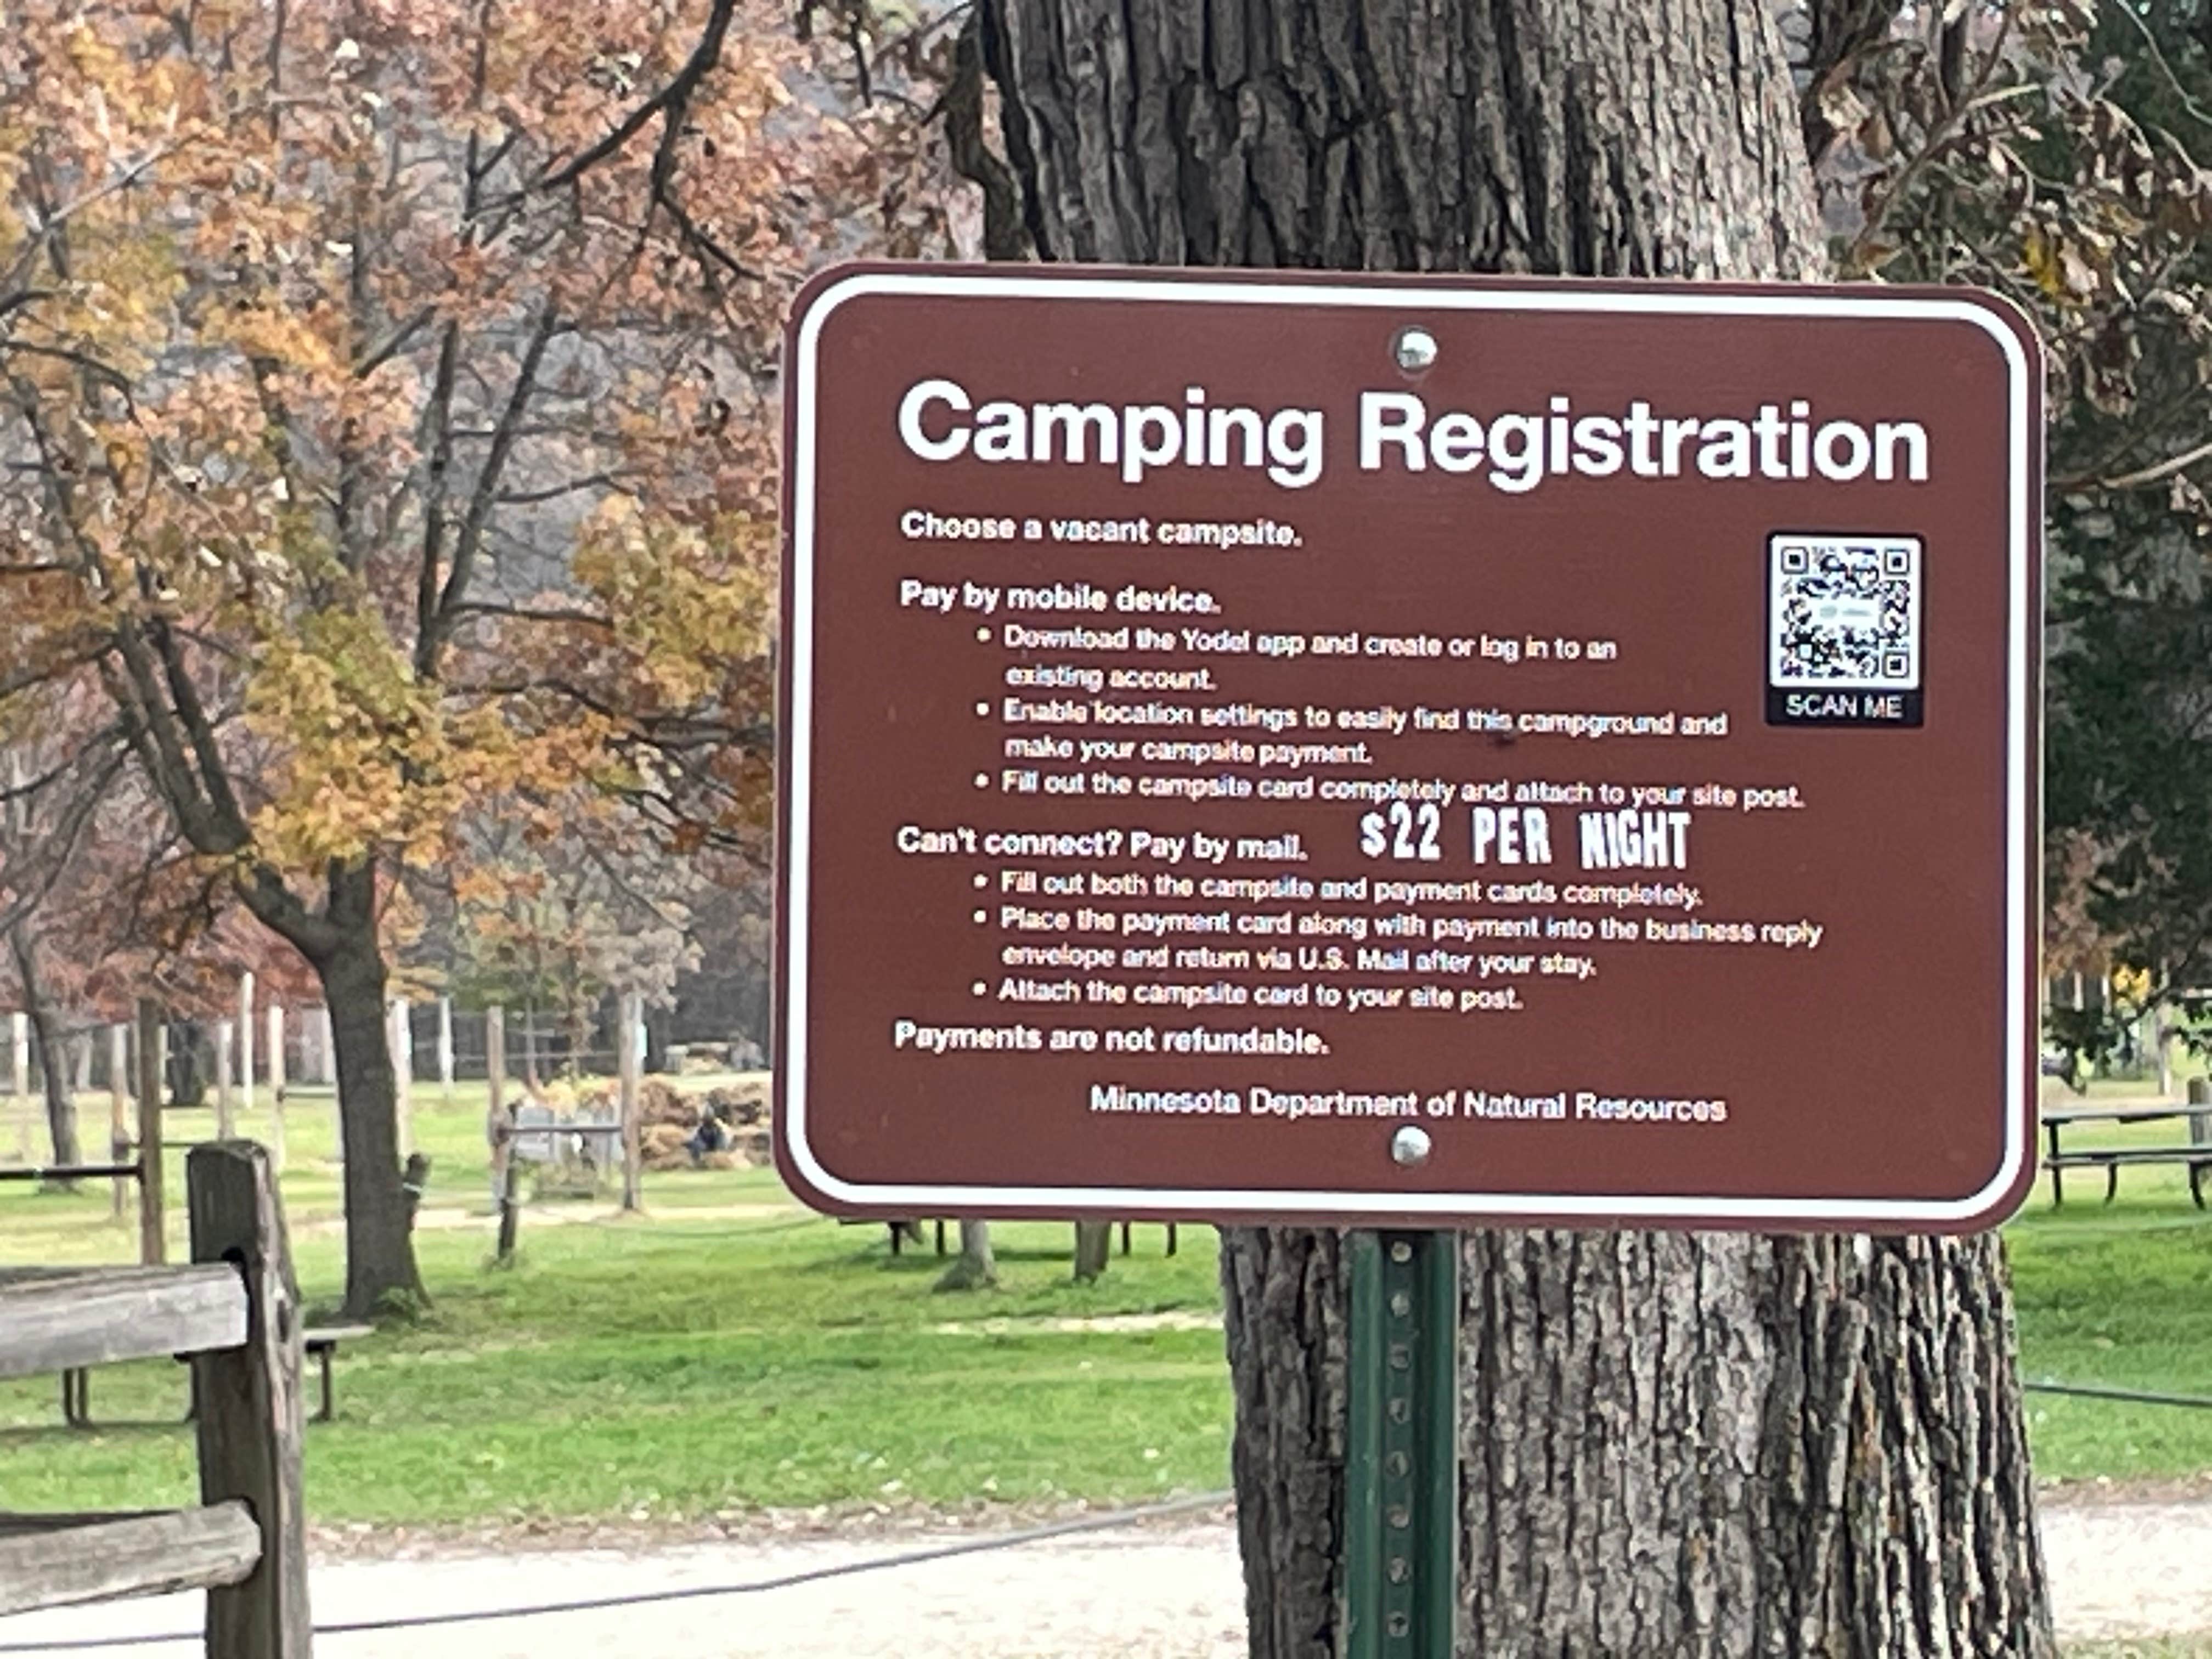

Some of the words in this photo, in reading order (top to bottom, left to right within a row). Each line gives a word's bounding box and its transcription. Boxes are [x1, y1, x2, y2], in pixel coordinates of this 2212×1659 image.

[899, 380, 1324, 488] Camping
[1360, 391, 1928, 493] Registration
[901, 510, 1017, 539] Choose
[1024, 519, 1043, 540] a
[1049, 517, 1151, 544] vacant
[1156, 518, 1302, 550] campsite.
[900, 579, 958, 613] Pay
[962, 581, 1001, 614] by
[1007, 583, 1108, 612] mobile
[1115, 584, 1221, 613] device.
[1004, 624, 1130, 650] Download
[1135, 627, 1177, 651] the
[1181, 628, 1251, 653] Yodel
[1256, 635, 1306, 658] app
[1310, 632, 1359, 654] and
[1363, 634, 1443, 657] create
[1447, 638, 1476, 657] or
[1480, 634, 1519, 663] log
[1525, 635, 1549, 659] in
[1553, 637, 1581, 659] to
[1586, 641, 1617, 659] an
[1006, 664, 1104, 693] existing
[1108, 668, 1216, 690] account.
[1003, 697, 1088, 724] Enable
[1093, 699, 1194, 725] location
[1200, 703, 1298, 733] settings
[1304, 705, 1331, 728] to
[1336, 706, 1408, 735] easily
[1413, 706, 1460, 730] find
[1466, 708, 1513, 731] this
[1517, 712, 1675, 738] campground
[1680, 713, 1728, 736] and
[1786, 693, 1858, 717] SCAN
[1864, 694, 1902, 719] ME
[1005, 735, 1074, 758] make
[1079, 740, 1136, 764] your
[1141, 740, 1255, 766] campsite
[1259, 742, 1373, 769] payment.
[1002, 769, 1039, 793] Fill
[1043, 772, 1085, 794] out
[1091, 771, 1132, 794] the
[1138, 776, 1252, 802] campsite
[1257, 776, 1314, 799] card
[1318, 777, 1457, 808] completely
[1460, 778, 1509, 803] and
[1514, 781, 1594, 804] attach
[1598, 783, 1625, 805] to
[1631, 787, 1687, 810] your
[1692, 784, 1737, 807] site
[1743, 786, 1804, 812] post.
[897, 826, 978, 854] Can't
[984, 829, 1124, 858] connect?
[1130, 831, 1186, 864] Pay
[1192, 831, 1230, 864] by
[1237, 834, 1308, 861] mail.
[1361, 800, 1441, 860] $22
[1472, 806, 1552, 864] PER
[1579, 808, 1691, 870] NIGHT
[1001, 870, 1037, 893] Fill
[1042, 873, 1085, 895] out
[1091, 872, 1149, 895] both
[1153, 873, 1194, 898] the
[1200, 876, 1314, 904] campsite
[1320, 877, 1368, 900] and
[1374, 880, 1482, 906] payment
[1486, 880, 1558, 904] cards
[1562, 882, 1703, 912] completely.
[1001, 906, 1070, 931] Place
[1076, 907, 1116, 932] the
[1122, 911, 1231, 937] payment
[1237, 911, 1292, 934] card
[1298, 911, 1368, 941] along
[1374, 912, 1426, 936] with
[1432, 916, 1541, 943] payment
[1546, 917, 1594, 940] into
[1599, 916, 1639, 940] the
[1645, 918, 1757, 943] business
[1760, 919, 1824, 949] reply
[1002, 942, 1116, 971] envelope
[1121, 944, 1170, 968] and
[1175, 946, 1250, 968] return
[1256, 946, 1293, 970] via
[1298, 946, 1350, 971] U.S.
[1357, 947, 1409, 971] Mail
[1415, 949, 1474, 973] after
[1478, 955, 1536, 979] your
[1539, 952, 1596, 980] stay.
[997, 977, 1081, 1002] Attach
[1086, 979, 1127, 1004] the
[1133, 983, 1248, 1009] campsite
[1253, 983, 1309, 1007] card
[1315, 983, 1342, 1007] to
[1347, 988, 1404, 1013] your
[1409, 985, 1454, 1009] site
[1460, 986, 1523, 1013] post.
[895, 1020, 1043, 1054] Payments
[1049, 1029, 1098, 1052] are
[1105, 1026, 1156, 1052] not
[1162, 1026, 1329, 1054] refundable.
[1090, 1084, 1242, 1114] Minnesota
[1250, 1087, 1419, 1120] Department
[1426, 1090, 1457, 1117] of
[1464, 1090, 1566, 1119] Natural
[1575, 1092, 1727, 1122] Resources
